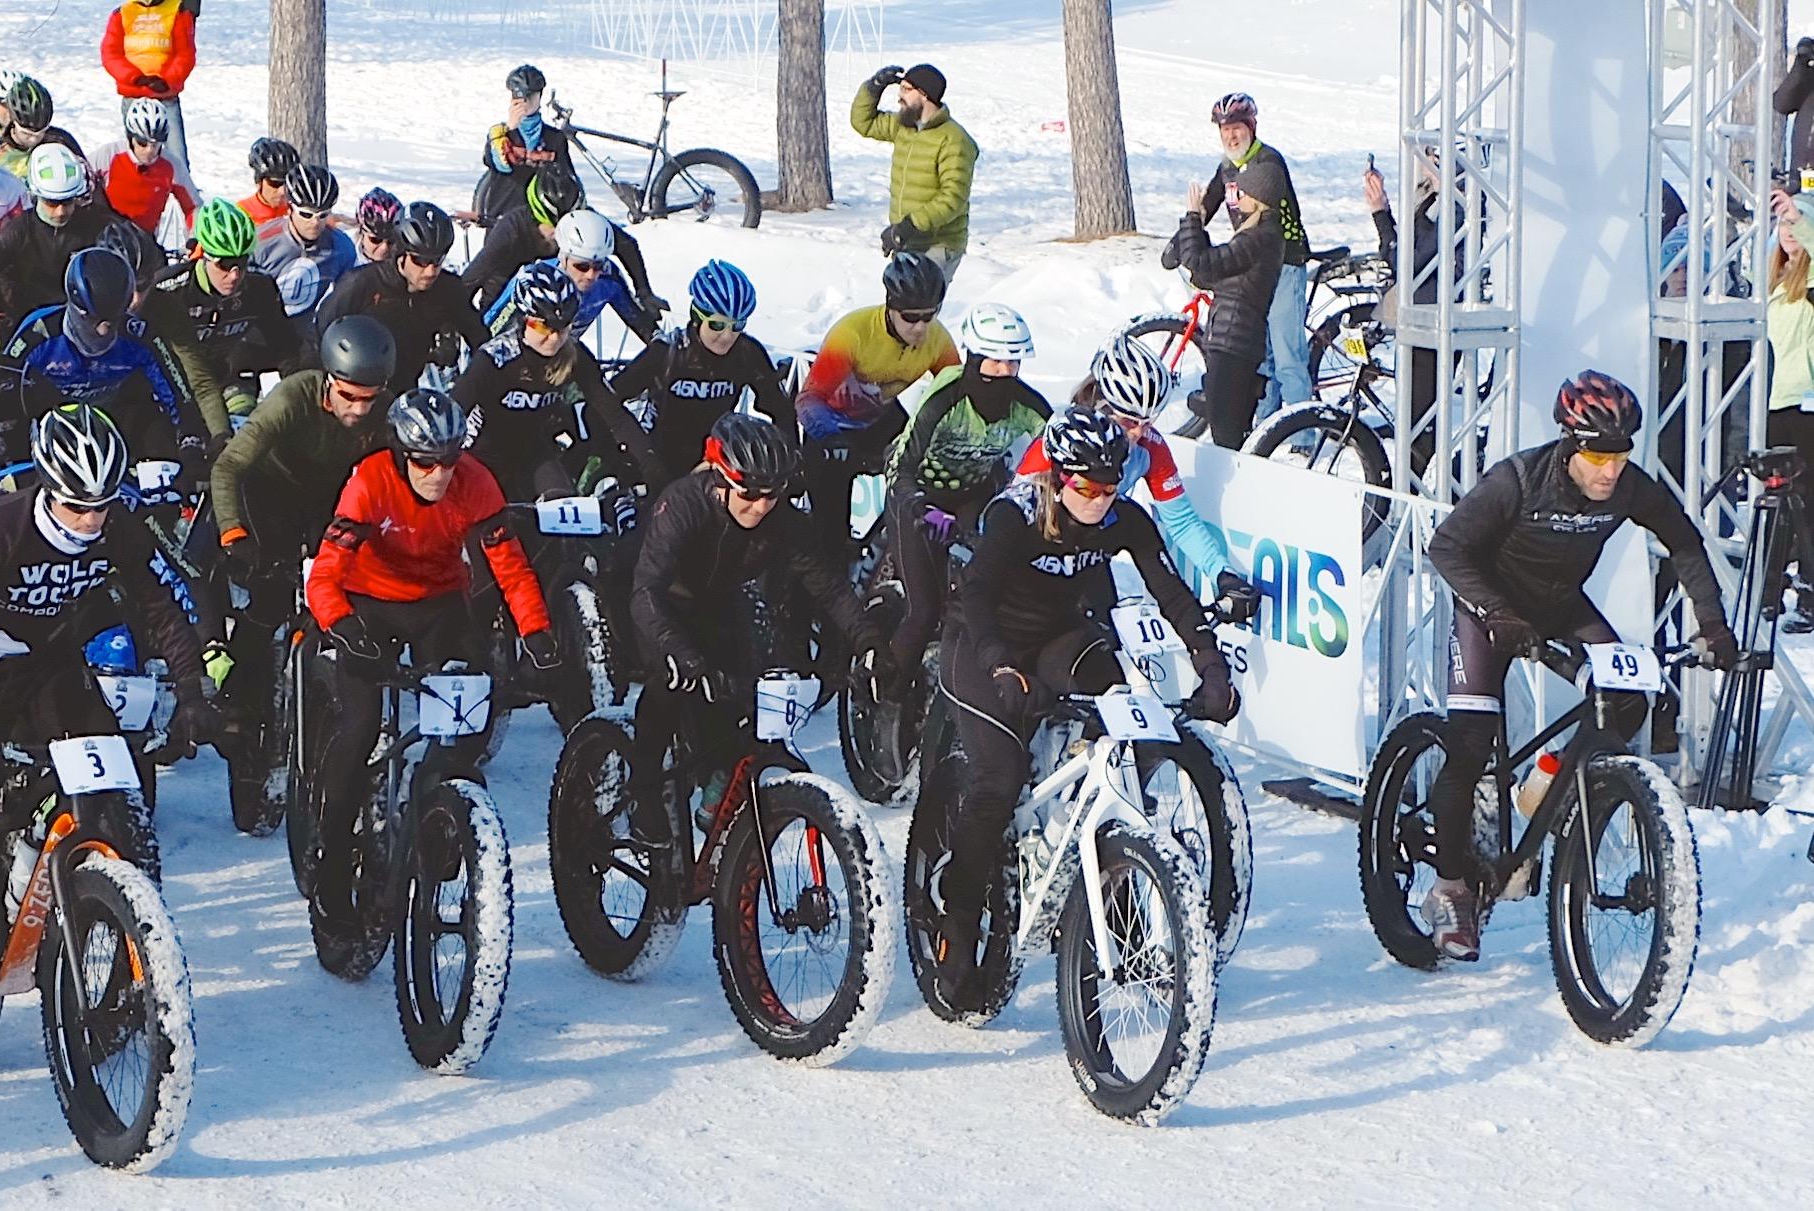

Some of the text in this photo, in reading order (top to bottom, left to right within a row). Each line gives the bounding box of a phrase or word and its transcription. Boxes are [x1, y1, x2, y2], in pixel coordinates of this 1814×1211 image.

[559, 506, 581, 523] 11
[20, 559, 108, 584] WOLF
[1137, 618, 1165, 643] 10
[1612, 654, 1639, 677] 49
[453, 694, 465, 722] 1
[1131, 708, 1149, 729] 9
[87, 752, 106, 778] 3
